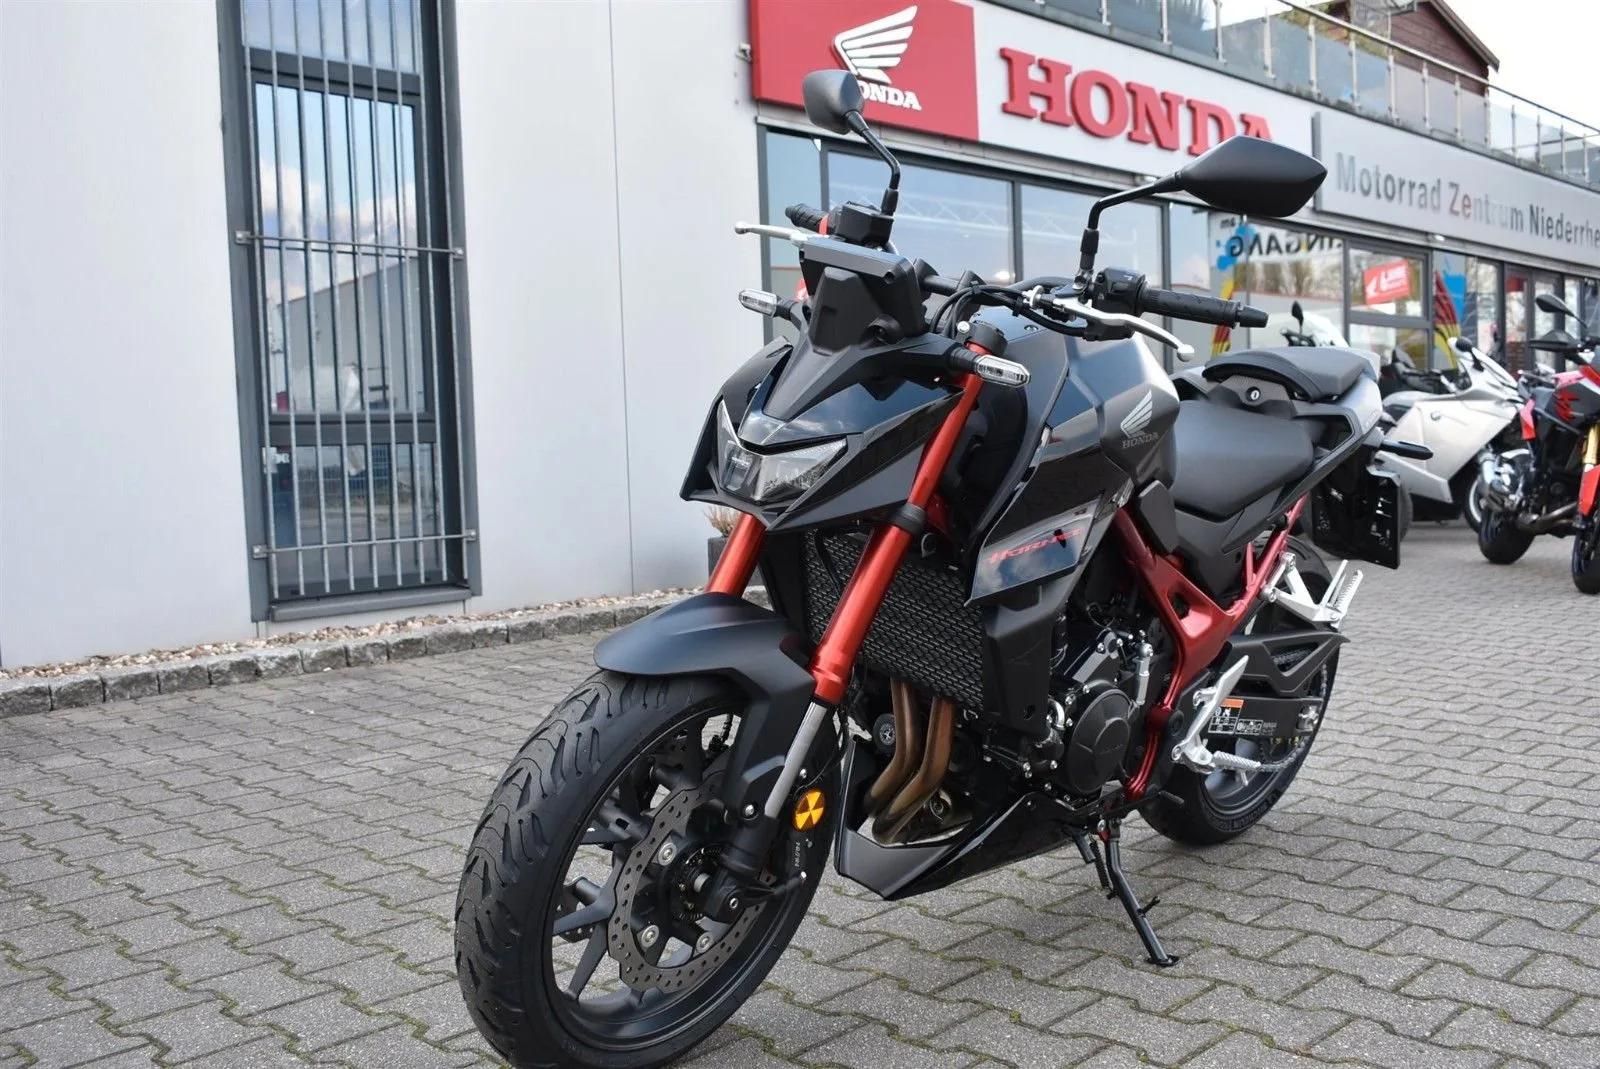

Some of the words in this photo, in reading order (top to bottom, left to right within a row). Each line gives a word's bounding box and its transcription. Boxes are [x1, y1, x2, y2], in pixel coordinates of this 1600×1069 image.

[857, 79, 922, 112] ONDA
[1336, 152, 1441, 212] Motorrad
[1448, 182, 1524, 233] Zentrum
[1121, 431, 1160, 450] HONDA
